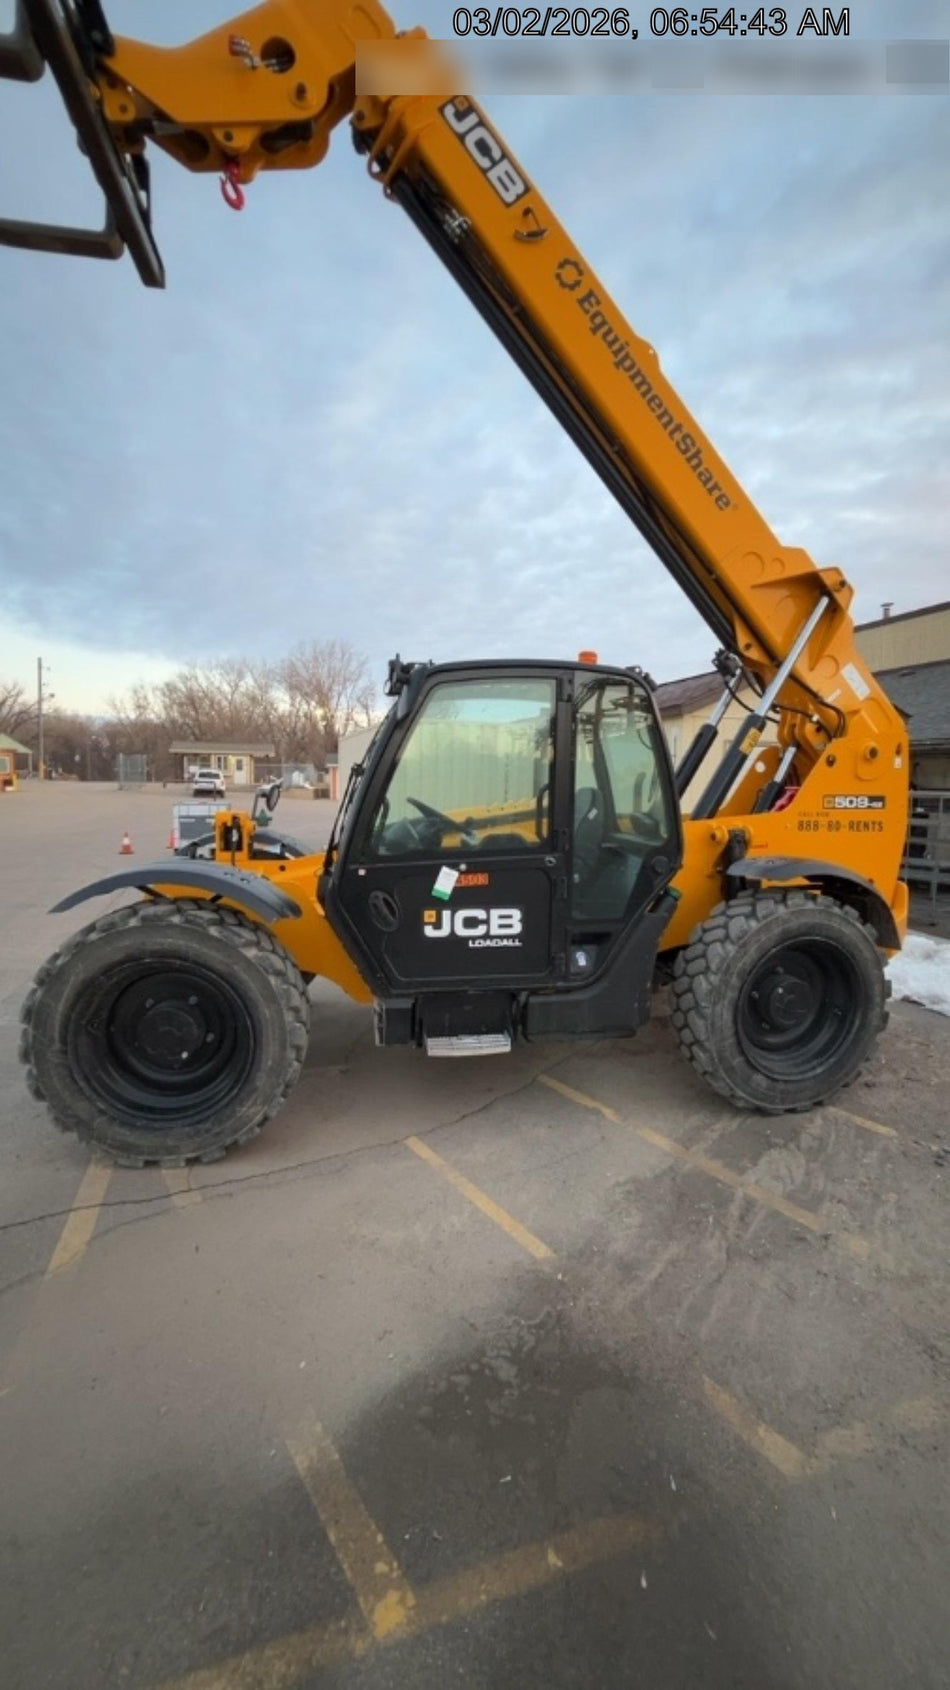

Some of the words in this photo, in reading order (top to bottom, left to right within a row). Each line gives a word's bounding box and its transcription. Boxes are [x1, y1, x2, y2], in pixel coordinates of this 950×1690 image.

[443, 103, 526, 204] JCB
[577, 289, 732, 511] EquipmentShare
[423, 909, 522, 937] JCB
[468, 938, 522, 947] LOADALL
